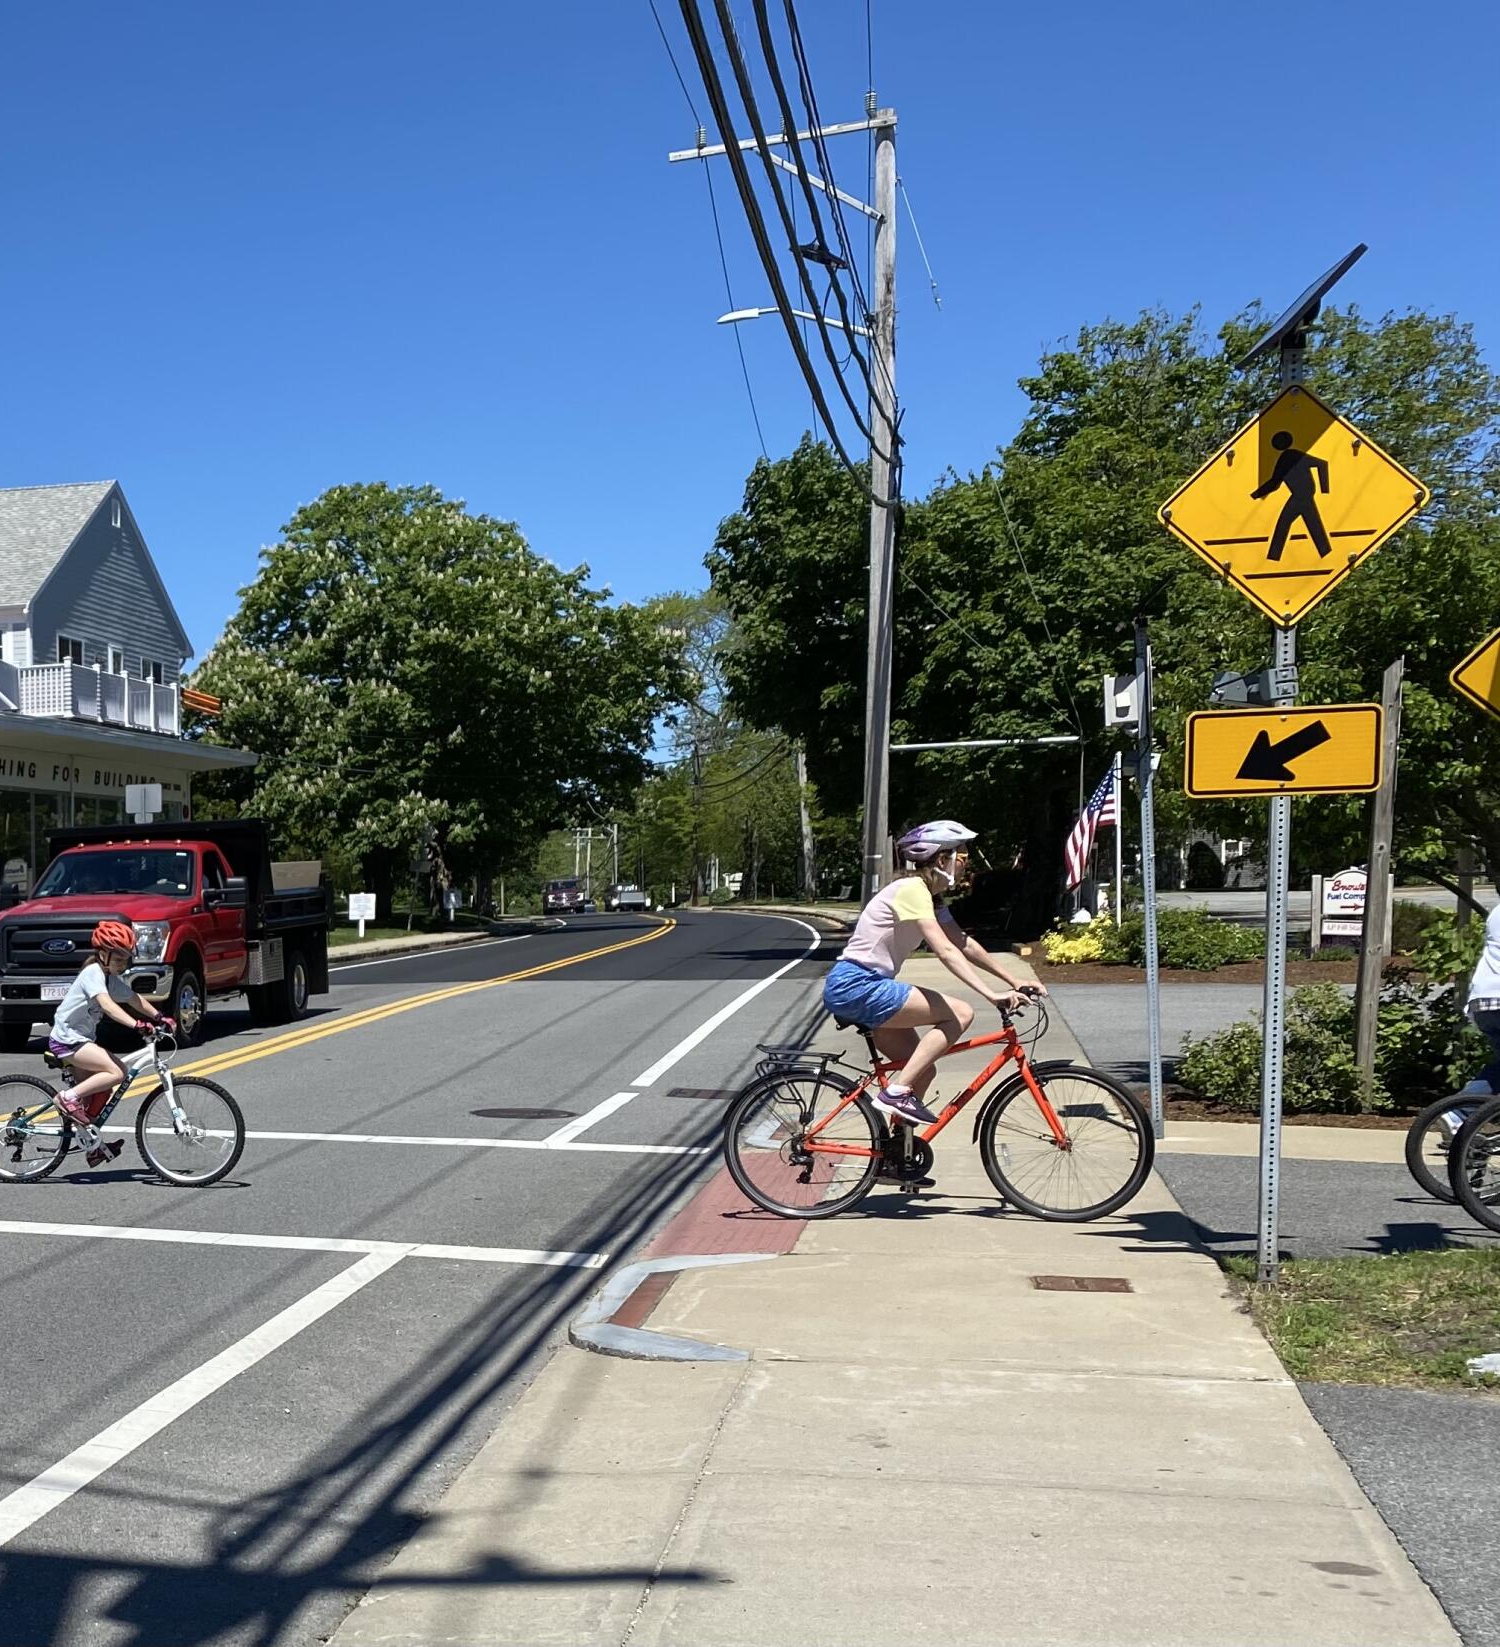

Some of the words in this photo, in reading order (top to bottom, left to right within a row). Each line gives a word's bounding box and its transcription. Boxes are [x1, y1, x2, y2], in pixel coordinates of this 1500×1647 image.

[52, 765, 80, 784] FOR
[1343, 893, 1365, 901] Comp
[48, 942, 67, 951] Ford
